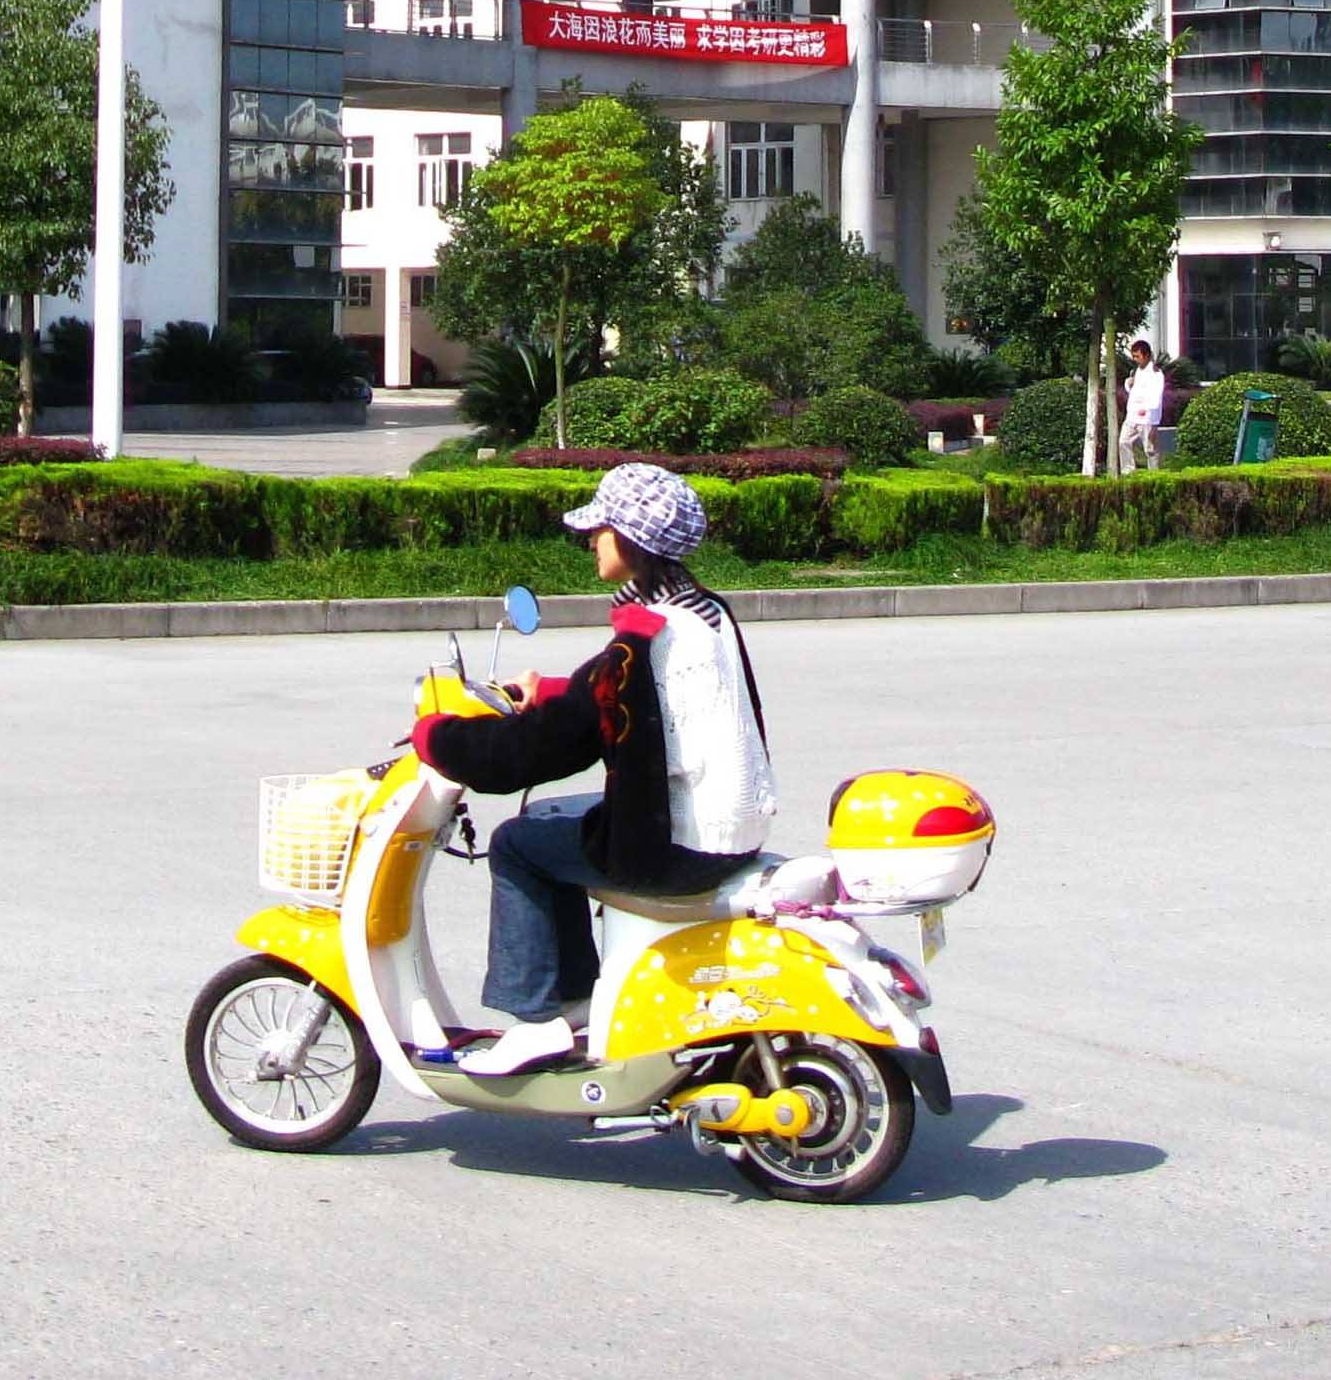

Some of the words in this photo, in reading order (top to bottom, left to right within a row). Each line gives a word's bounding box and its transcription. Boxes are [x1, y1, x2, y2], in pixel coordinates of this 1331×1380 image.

[549, 11, 686, 49] 大海因浪花而美丽
[696, 24, 825, 57] 求学因考研更精彩
